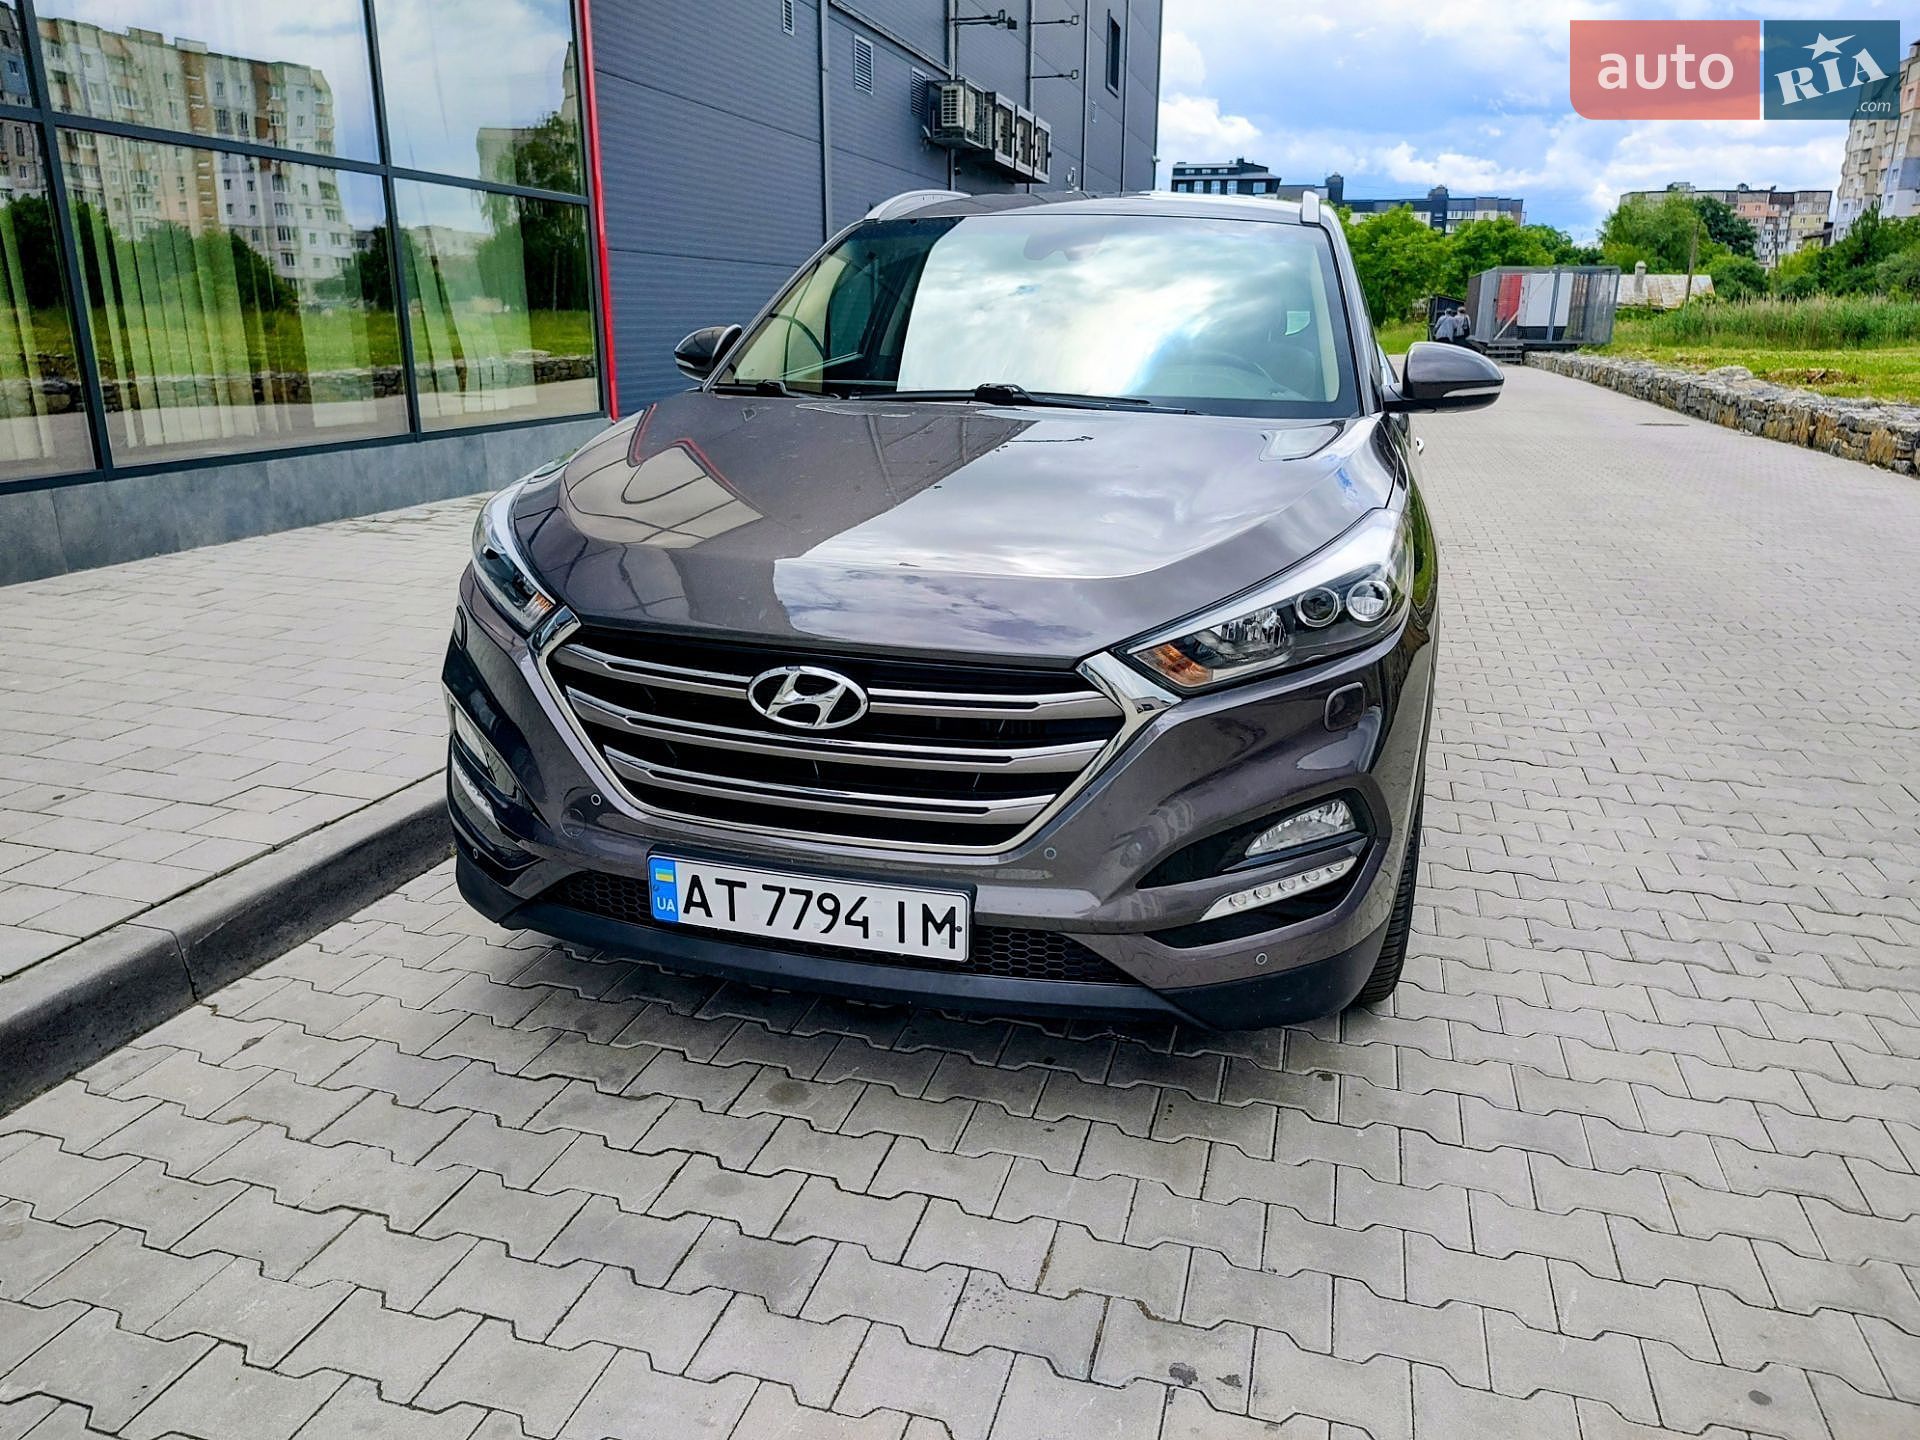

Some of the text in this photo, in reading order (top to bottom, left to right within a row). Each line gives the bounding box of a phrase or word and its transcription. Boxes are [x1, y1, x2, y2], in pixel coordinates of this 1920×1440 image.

[656, 896, 676, 913] UA
[682, 874, 957, 950] AT 7794 IM
